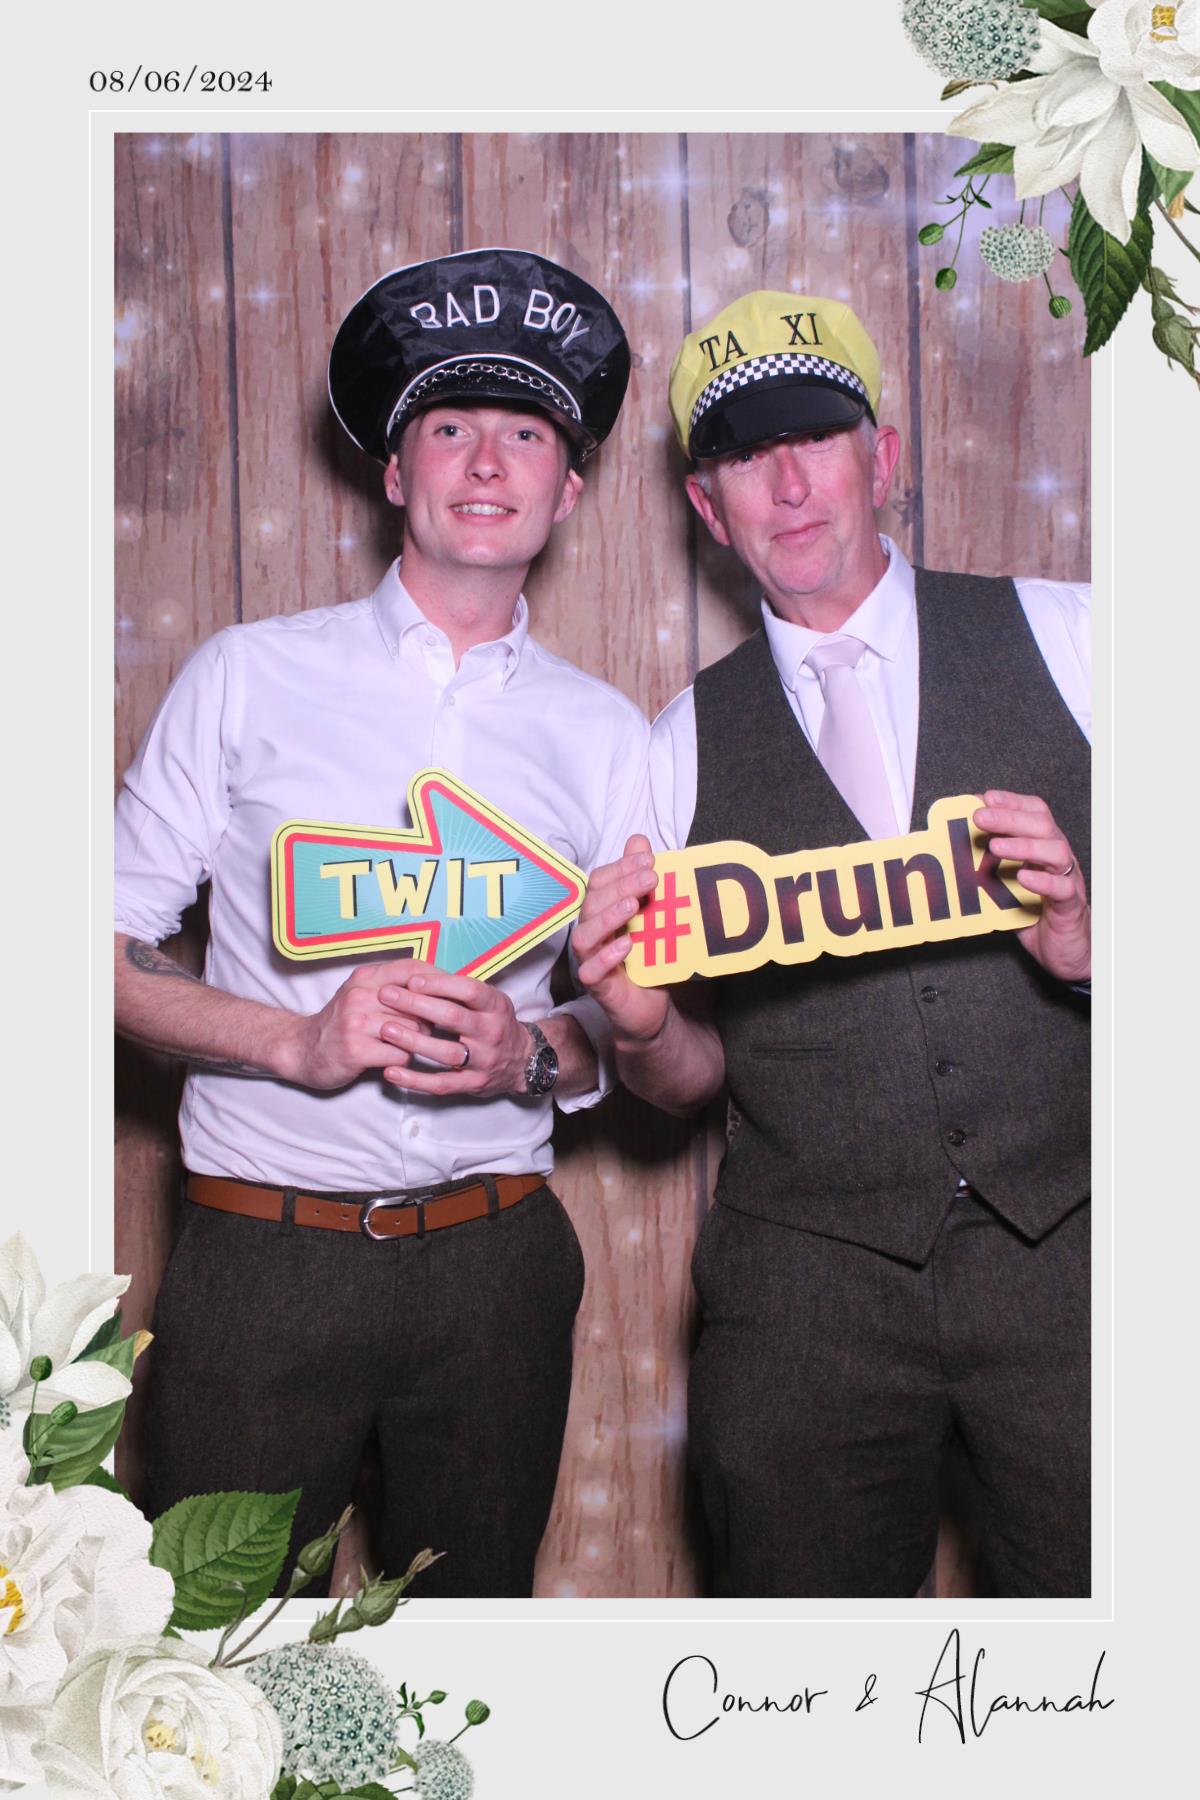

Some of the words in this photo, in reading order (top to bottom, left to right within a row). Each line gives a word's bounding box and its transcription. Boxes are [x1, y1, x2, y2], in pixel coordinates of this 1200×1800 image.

[409, 284, 500, 329] BAD
[523, 289, 590, 349] BOY
[319, 858, 520, 920] TWIT
[631, 817, 1023, 967] #Drunk
